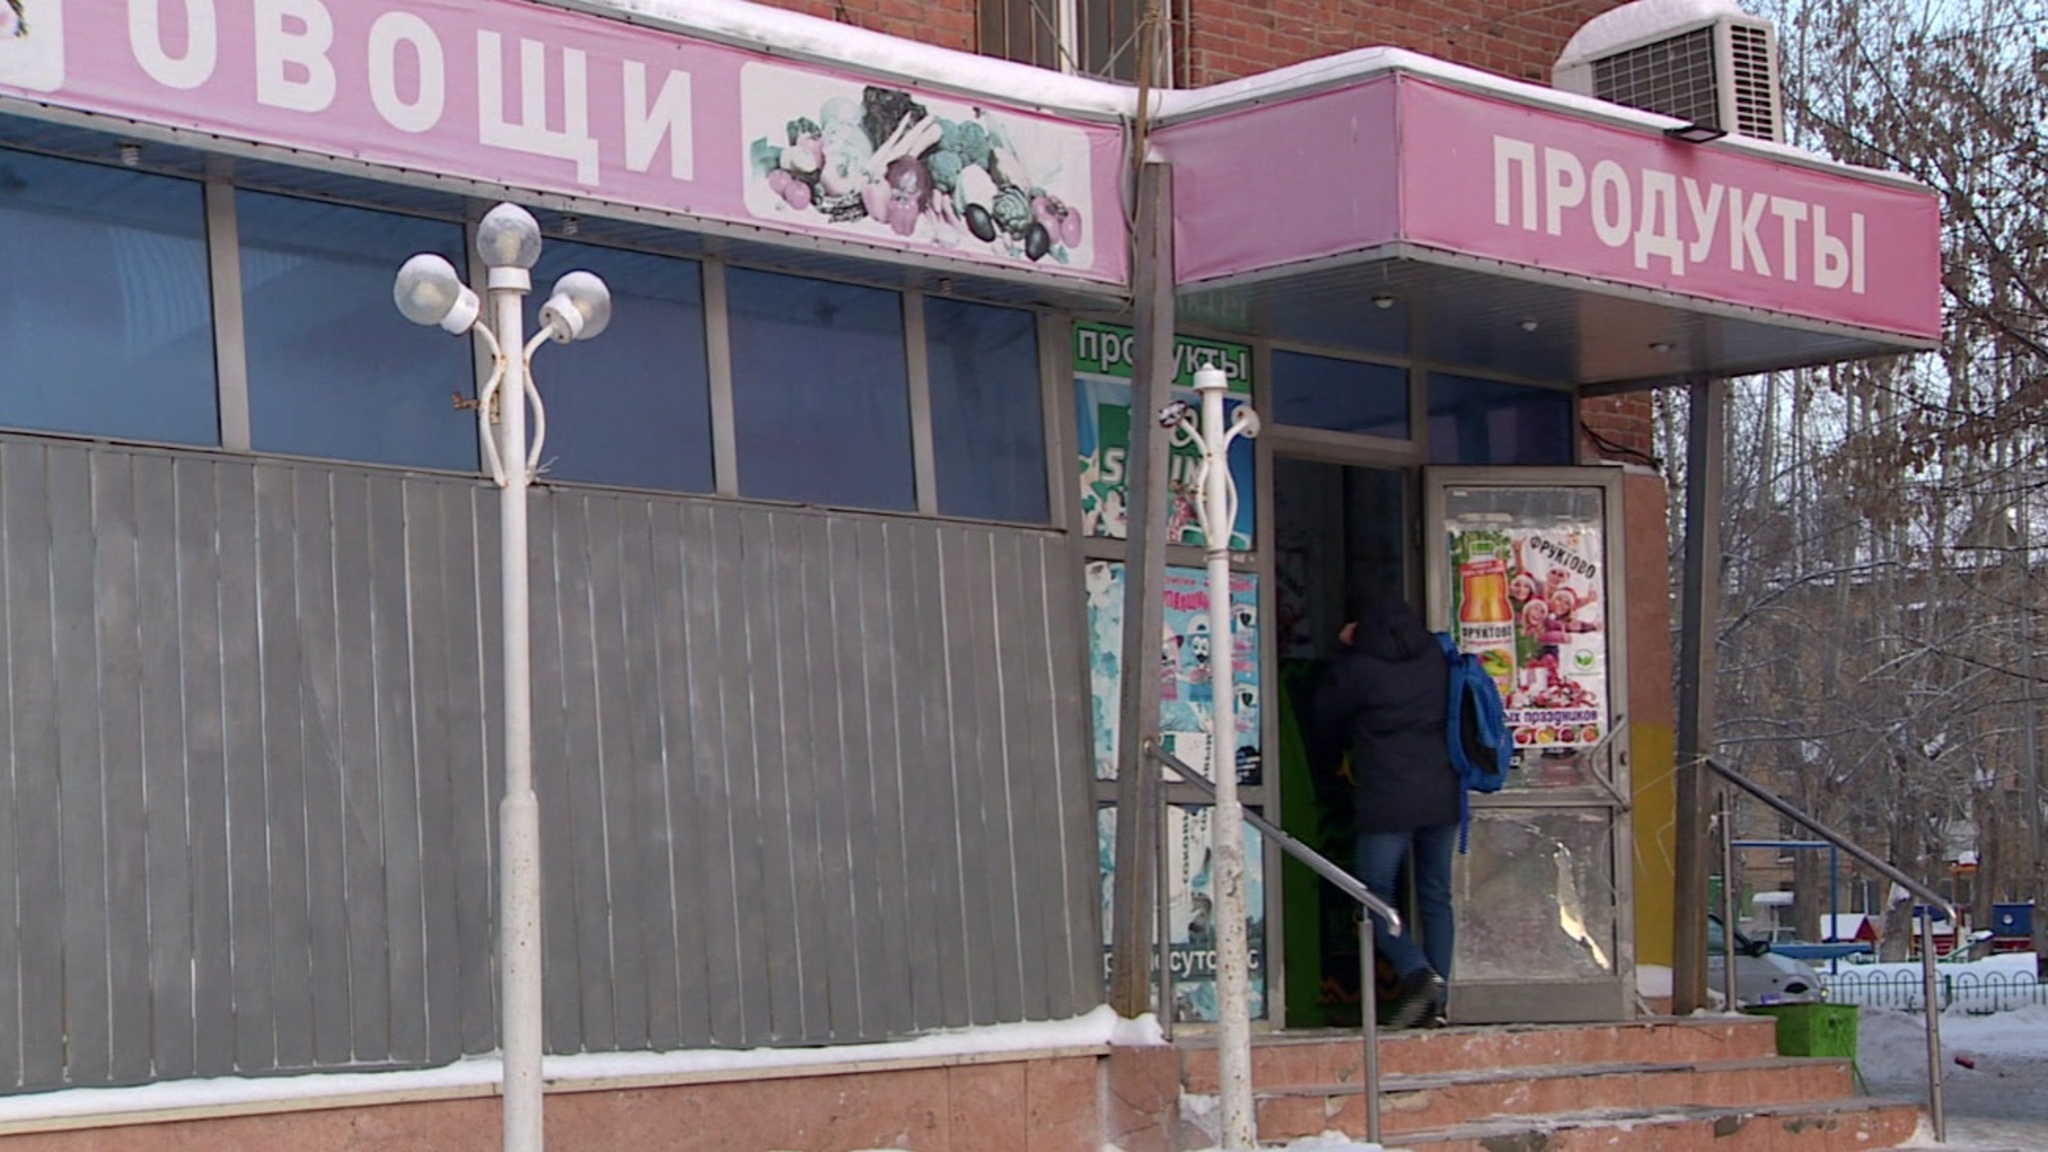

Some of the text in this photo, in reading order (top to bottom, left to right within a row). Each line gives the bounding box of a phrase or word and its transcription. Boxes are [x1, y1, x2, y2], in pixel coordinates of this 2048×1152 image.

[128, 0, 693, 186] ОВОЩИ
[1493, 135, 1866, 294] ПРОДУКТЫ
[1079, 329, 1247, 381] проукты
[1530, 536, 1596, 579] ФРУКТОВО
